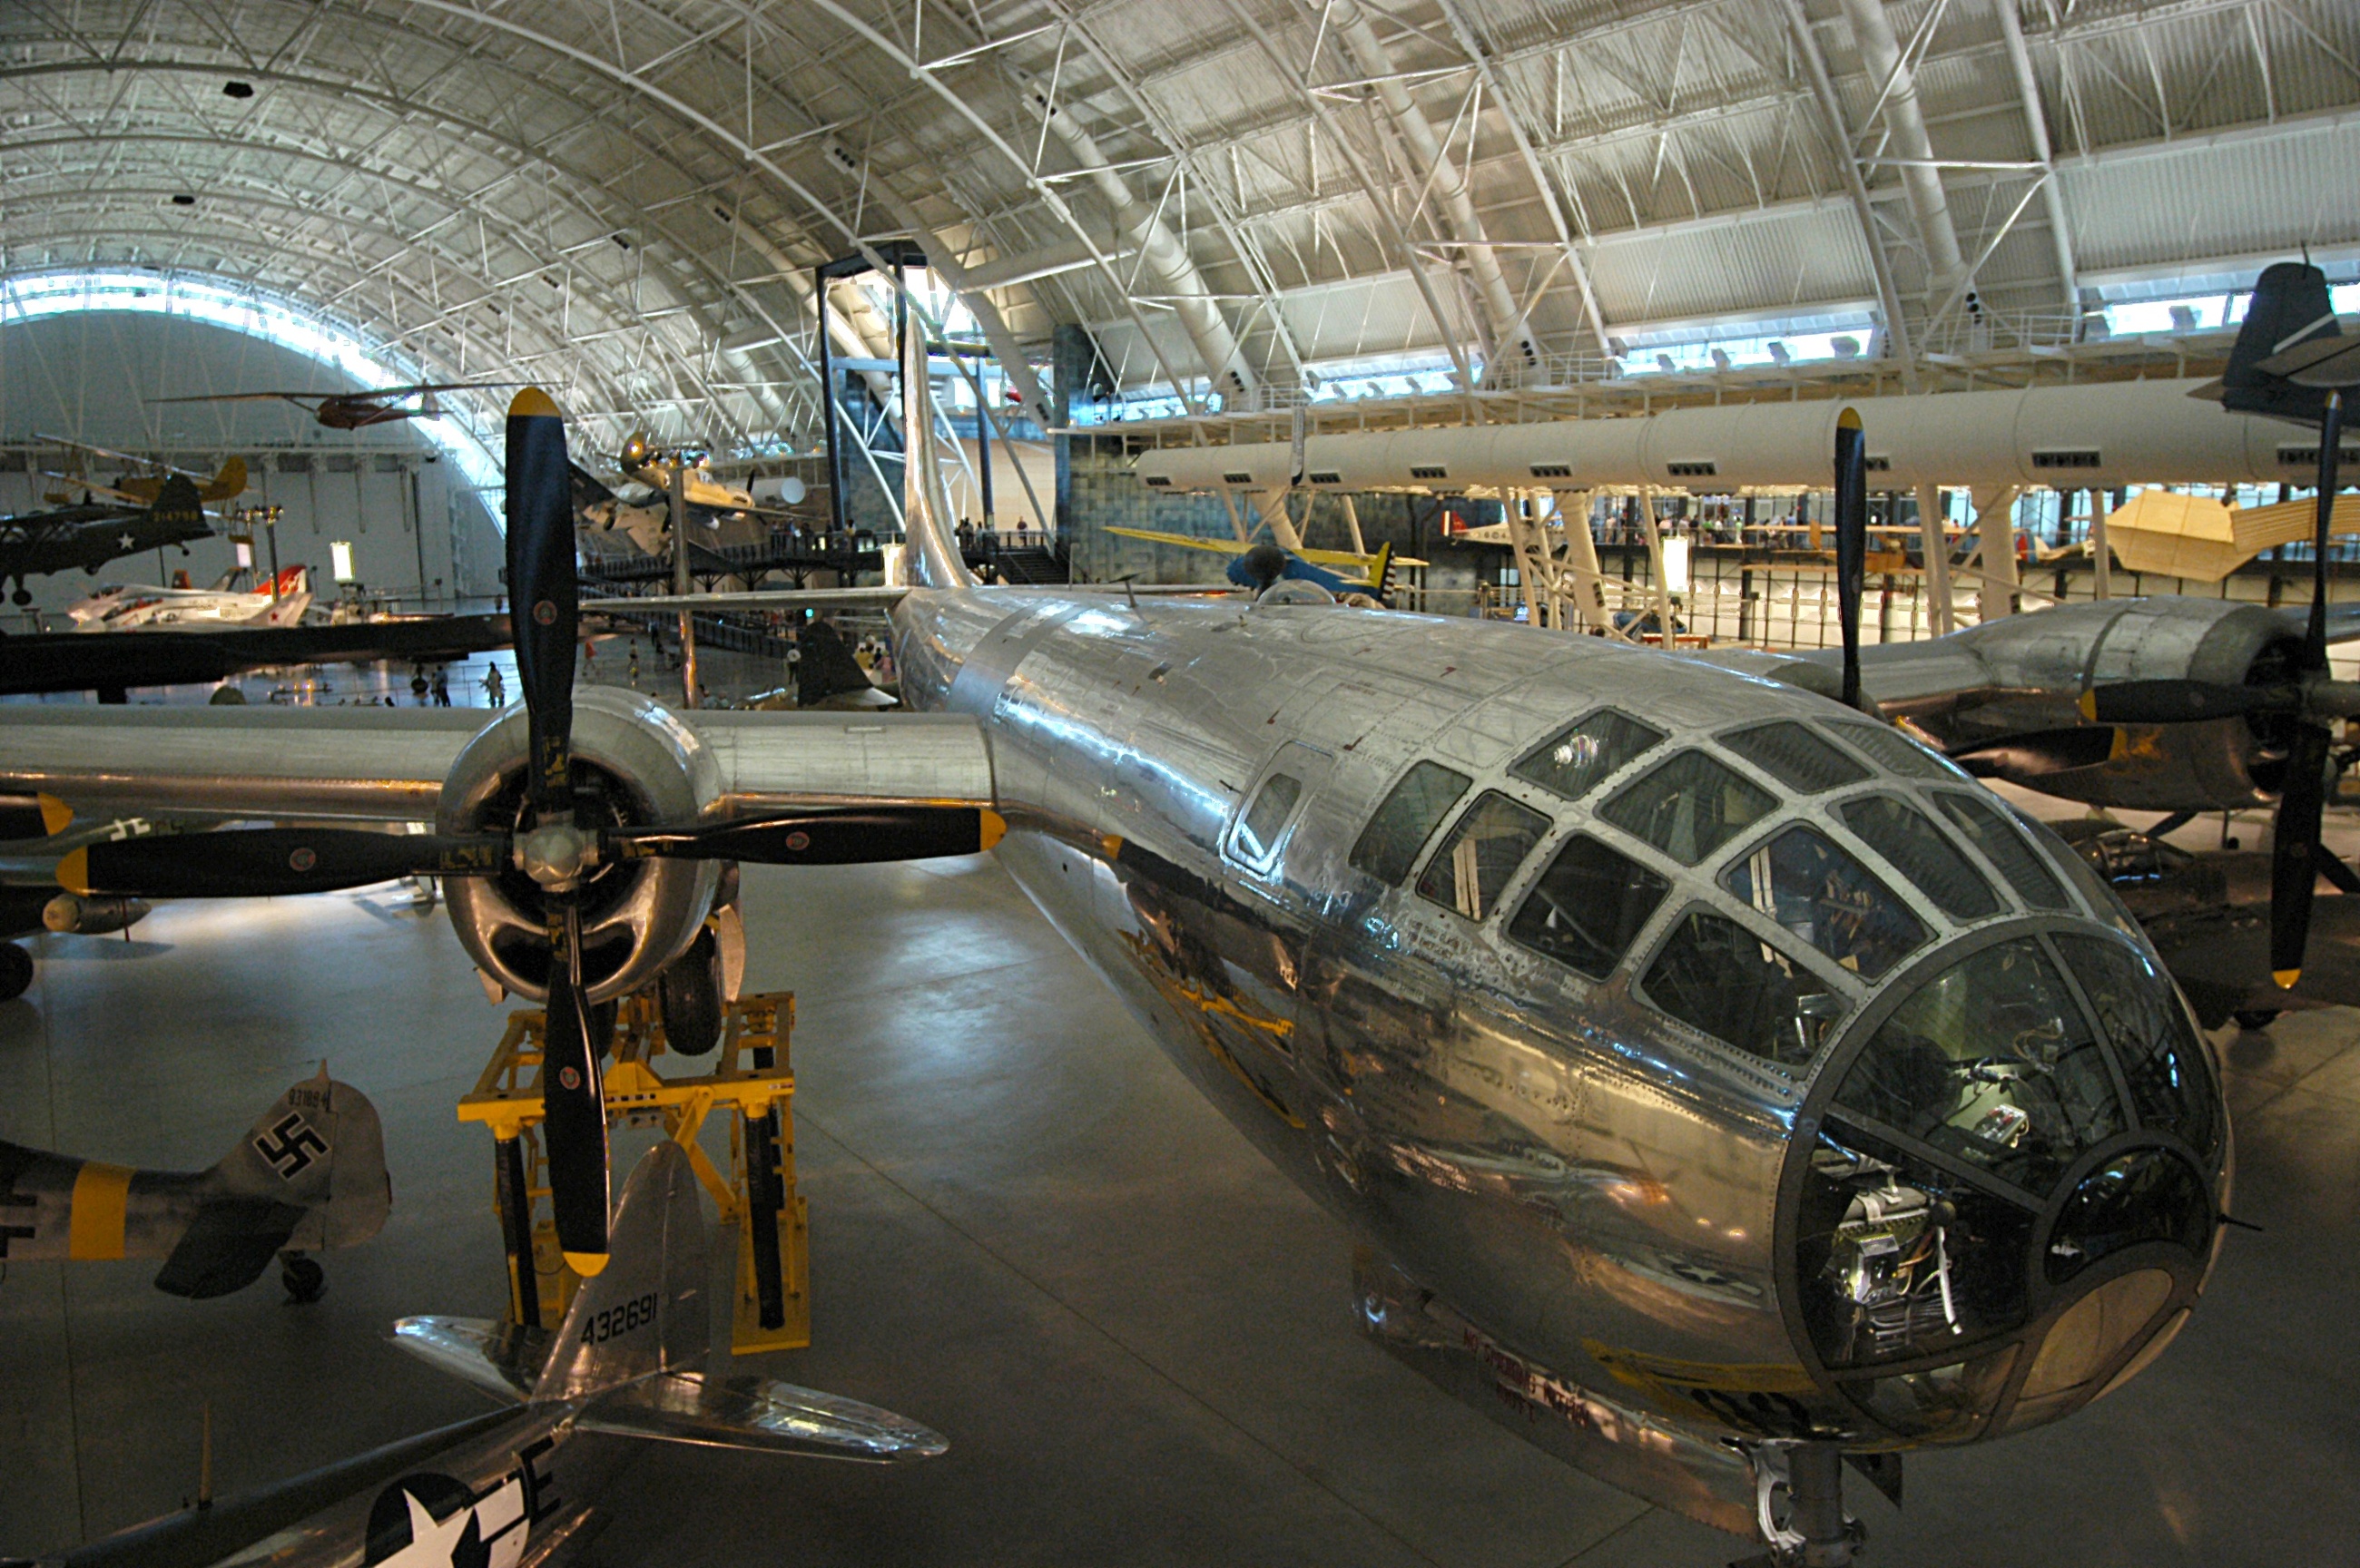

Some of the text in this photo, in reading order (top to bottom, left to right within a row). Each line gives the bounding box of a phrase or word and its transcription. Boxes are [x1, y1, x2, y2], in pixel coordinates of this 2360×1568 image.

[581, 1292, 657, 1345] 432691
[1464, 1328, 1590, 1429] NO SMOKING WITHIN
[520, 1436, 562, 1526] E
